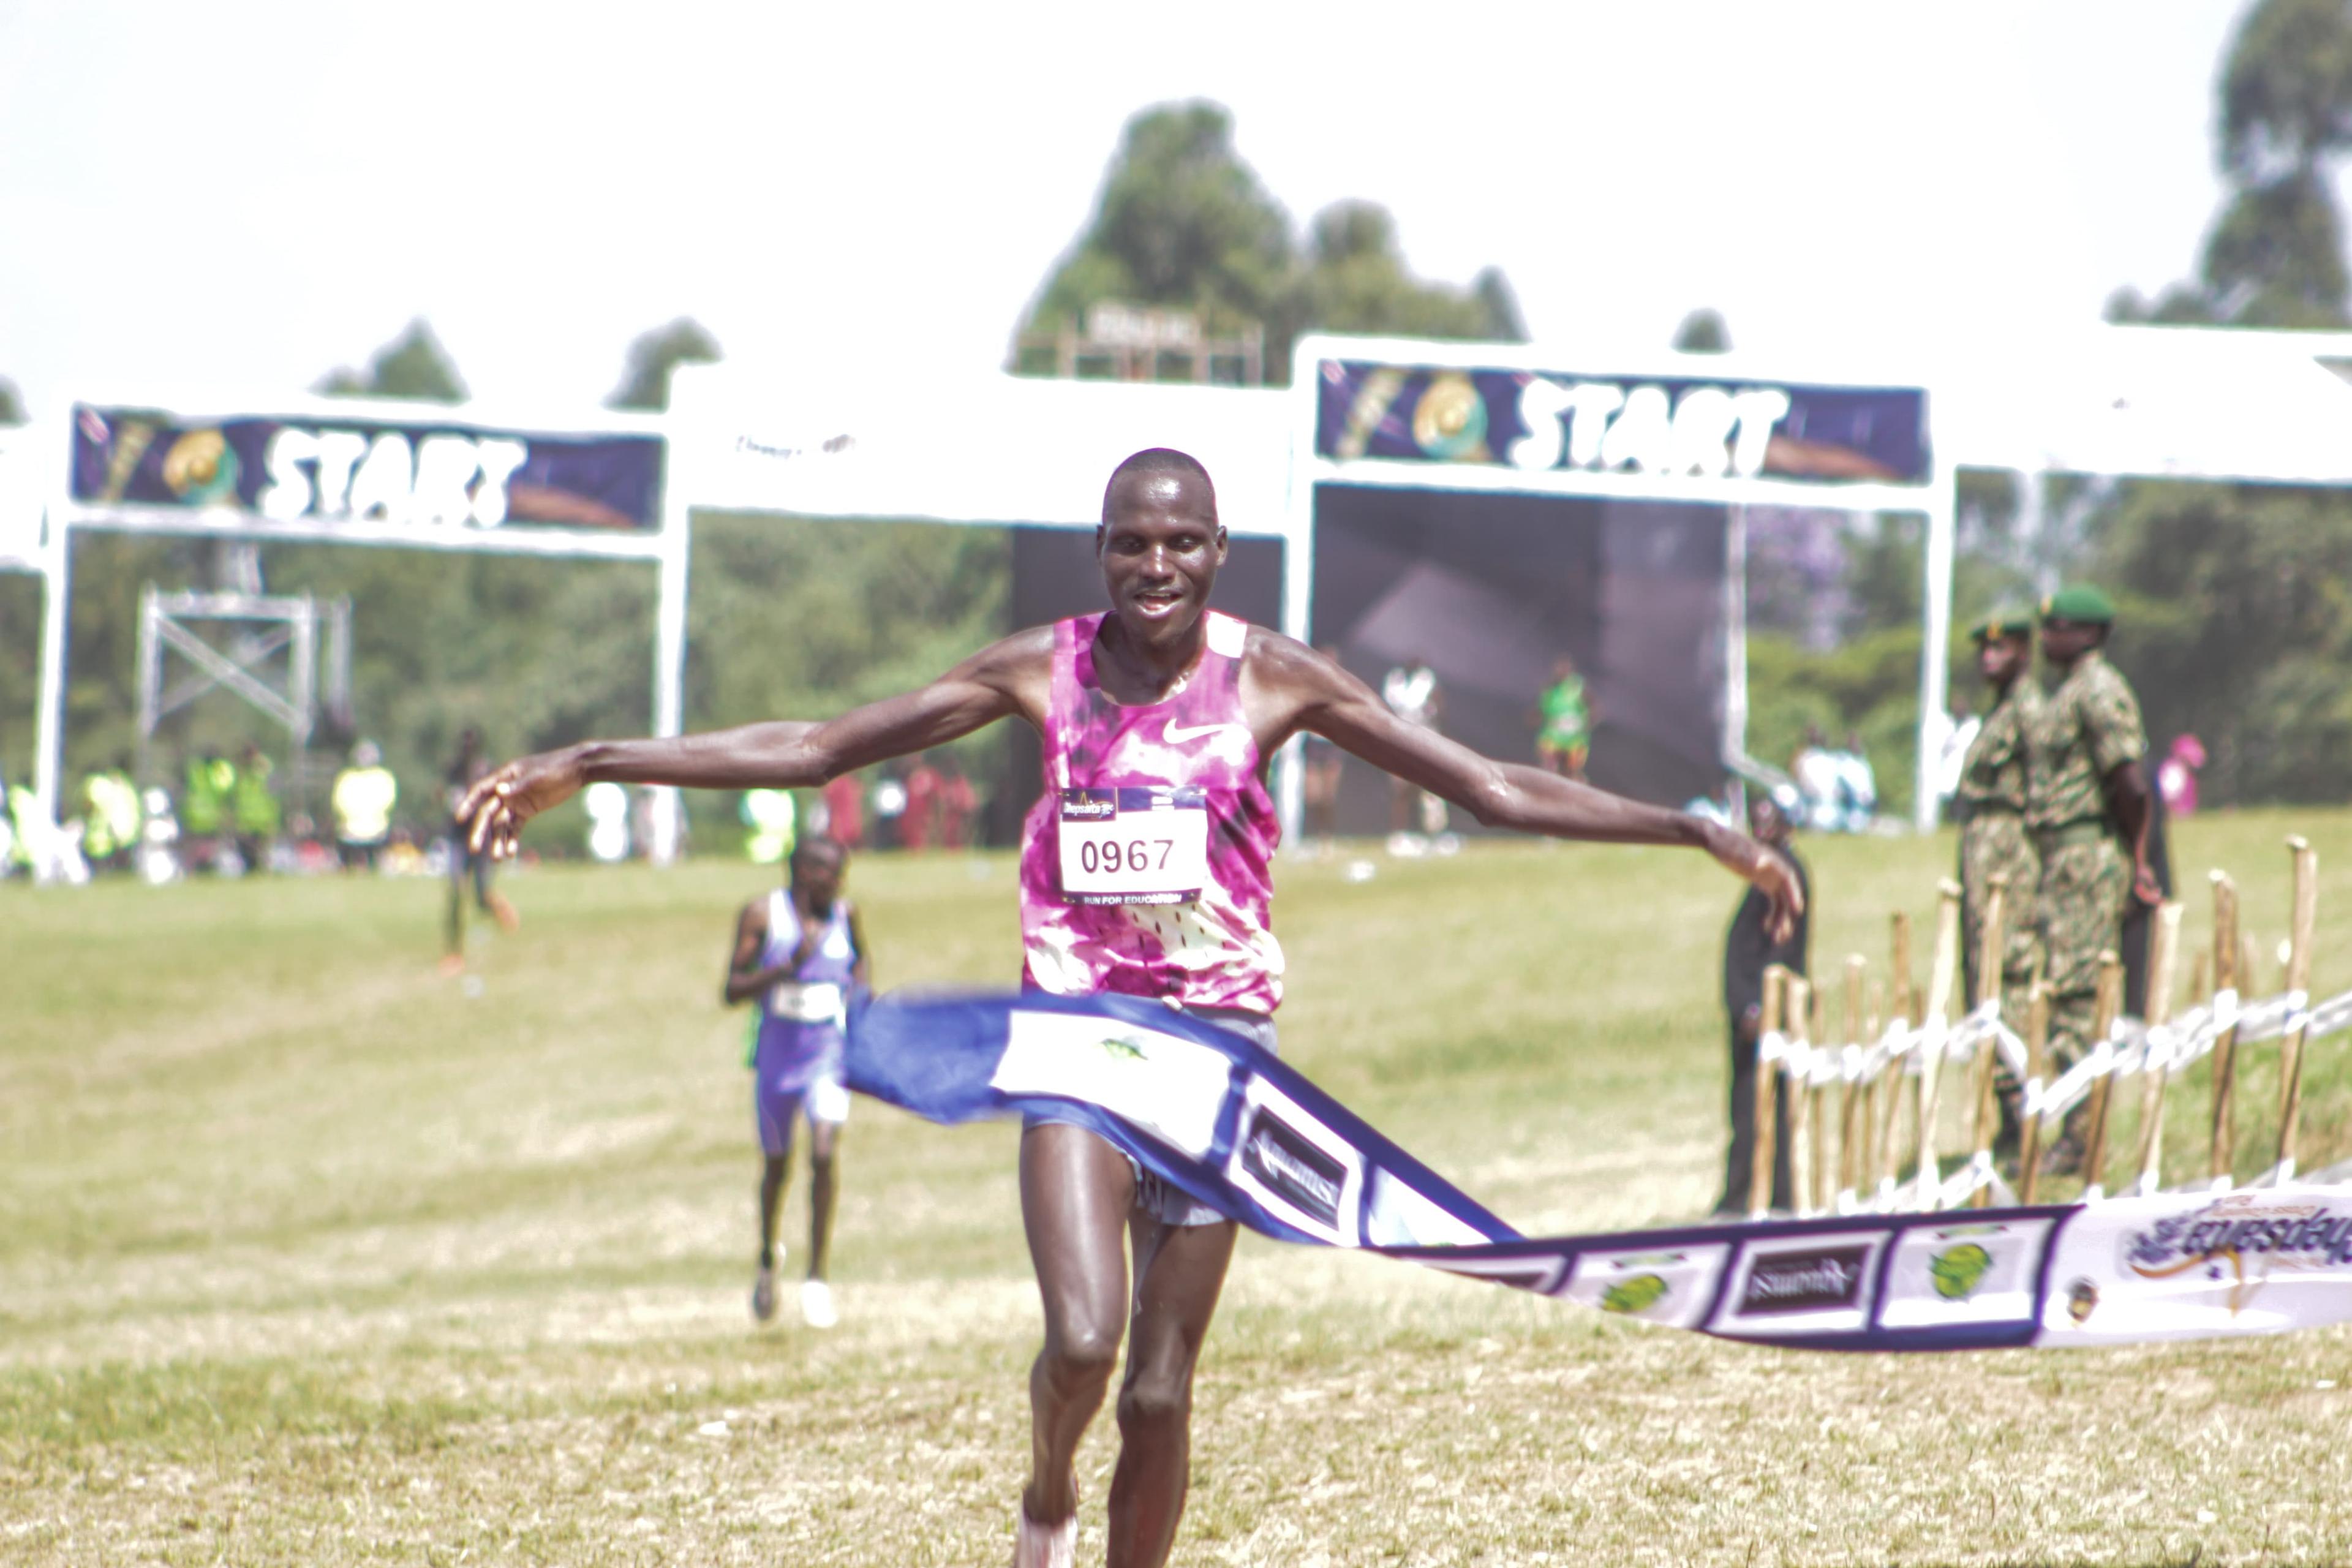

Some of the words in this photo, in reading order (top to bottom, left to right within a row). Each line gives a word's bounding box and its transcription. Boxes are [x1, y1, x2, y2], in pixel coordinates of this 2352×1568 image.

[1506, 377, 1791, 475] START
[255, 427, 528, 528] START
[1082, 839, 1174, 873] 0967
[1084, 896, 1101, 905] RUN
[1102, 896, 1122, 905] FOR
